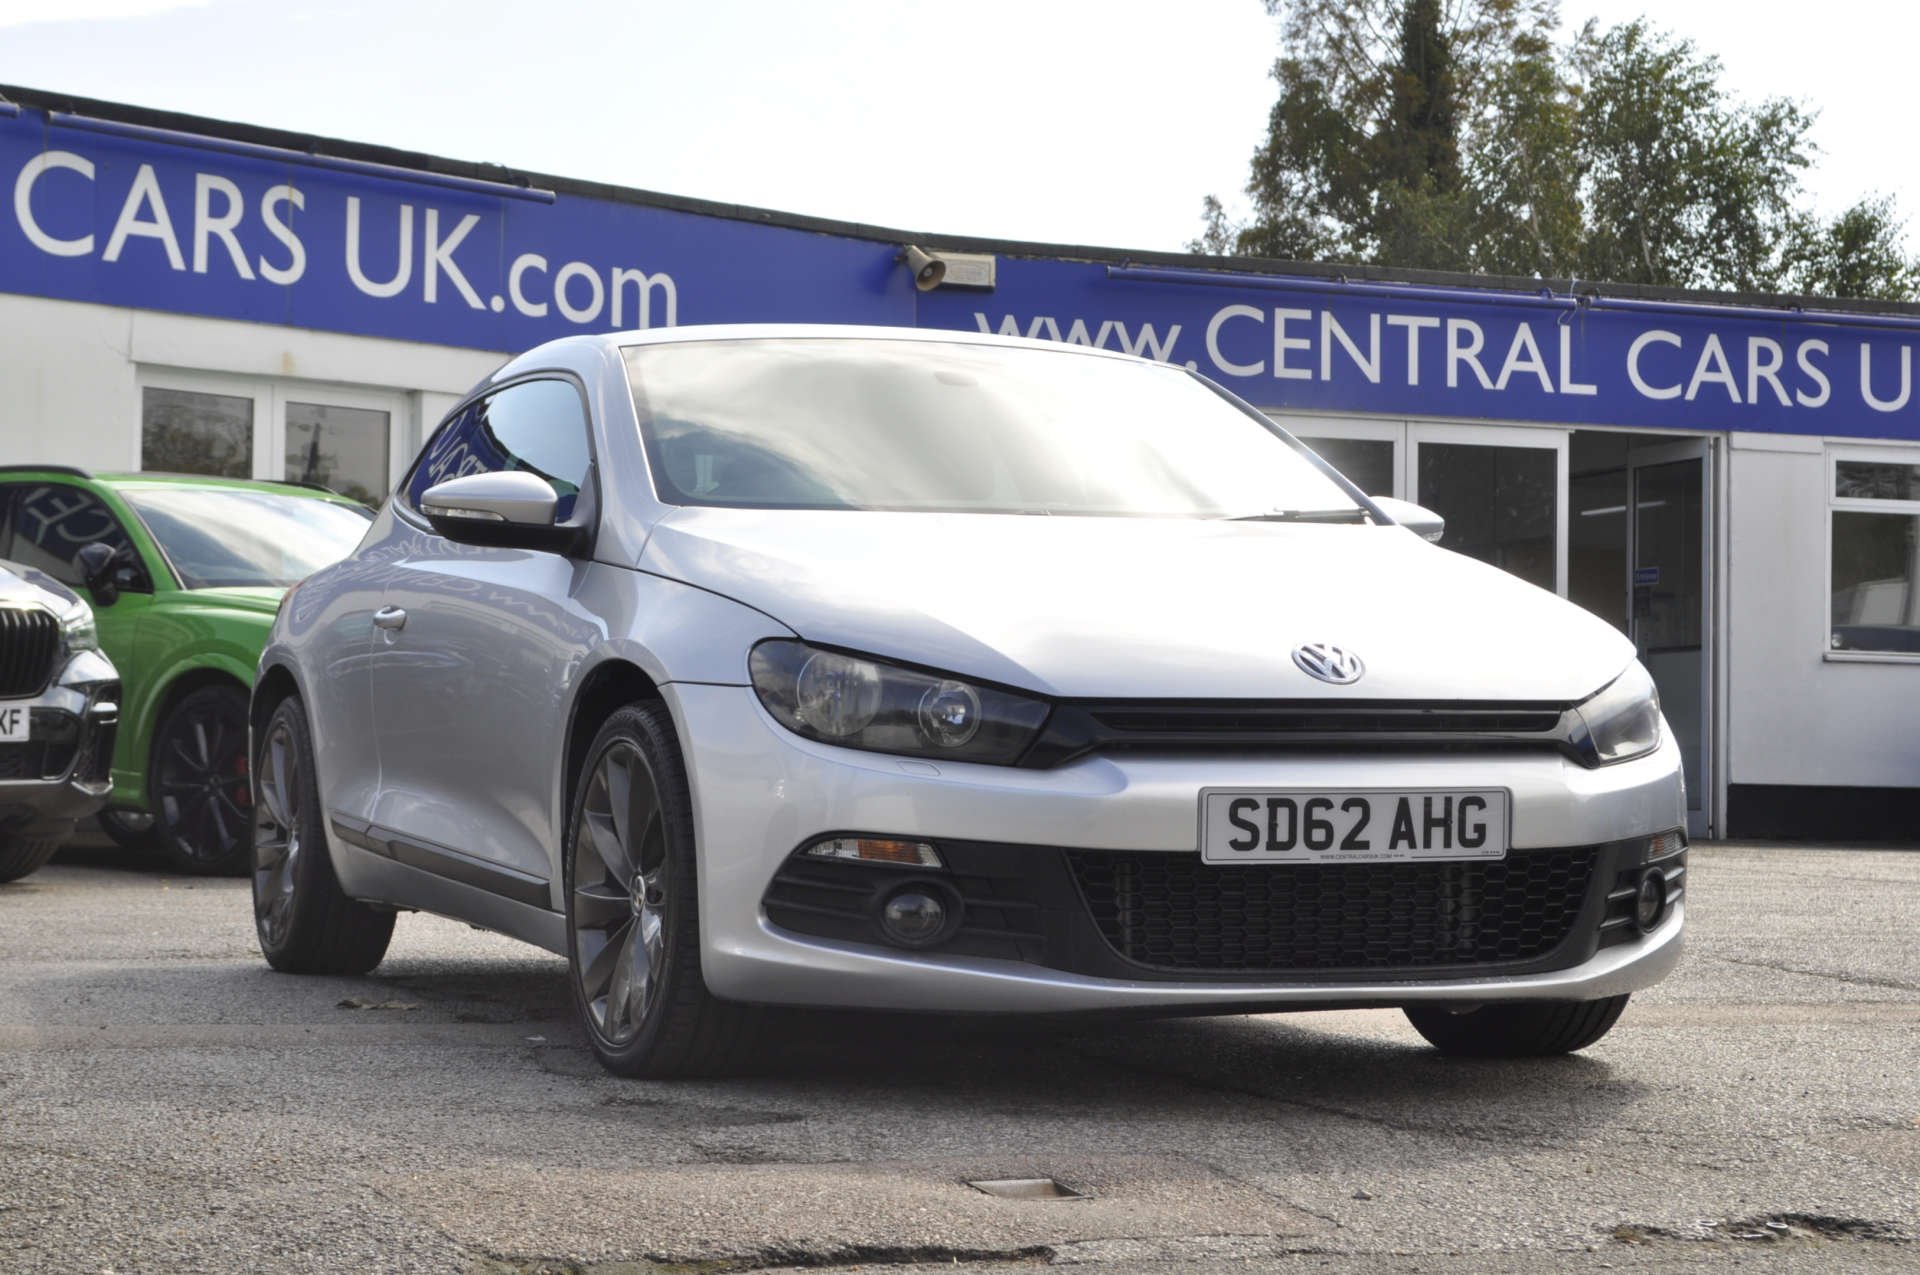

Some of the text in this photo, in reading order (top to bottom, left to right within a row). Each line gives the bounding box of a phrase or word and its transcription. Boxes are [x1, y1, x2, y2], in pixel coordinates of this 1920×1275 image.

[13, 150, 678, 329] CARS UK.com
[1626, 330, 1831, 408] CARS
[1228, 796, 1487, 851] SD62 AHG
